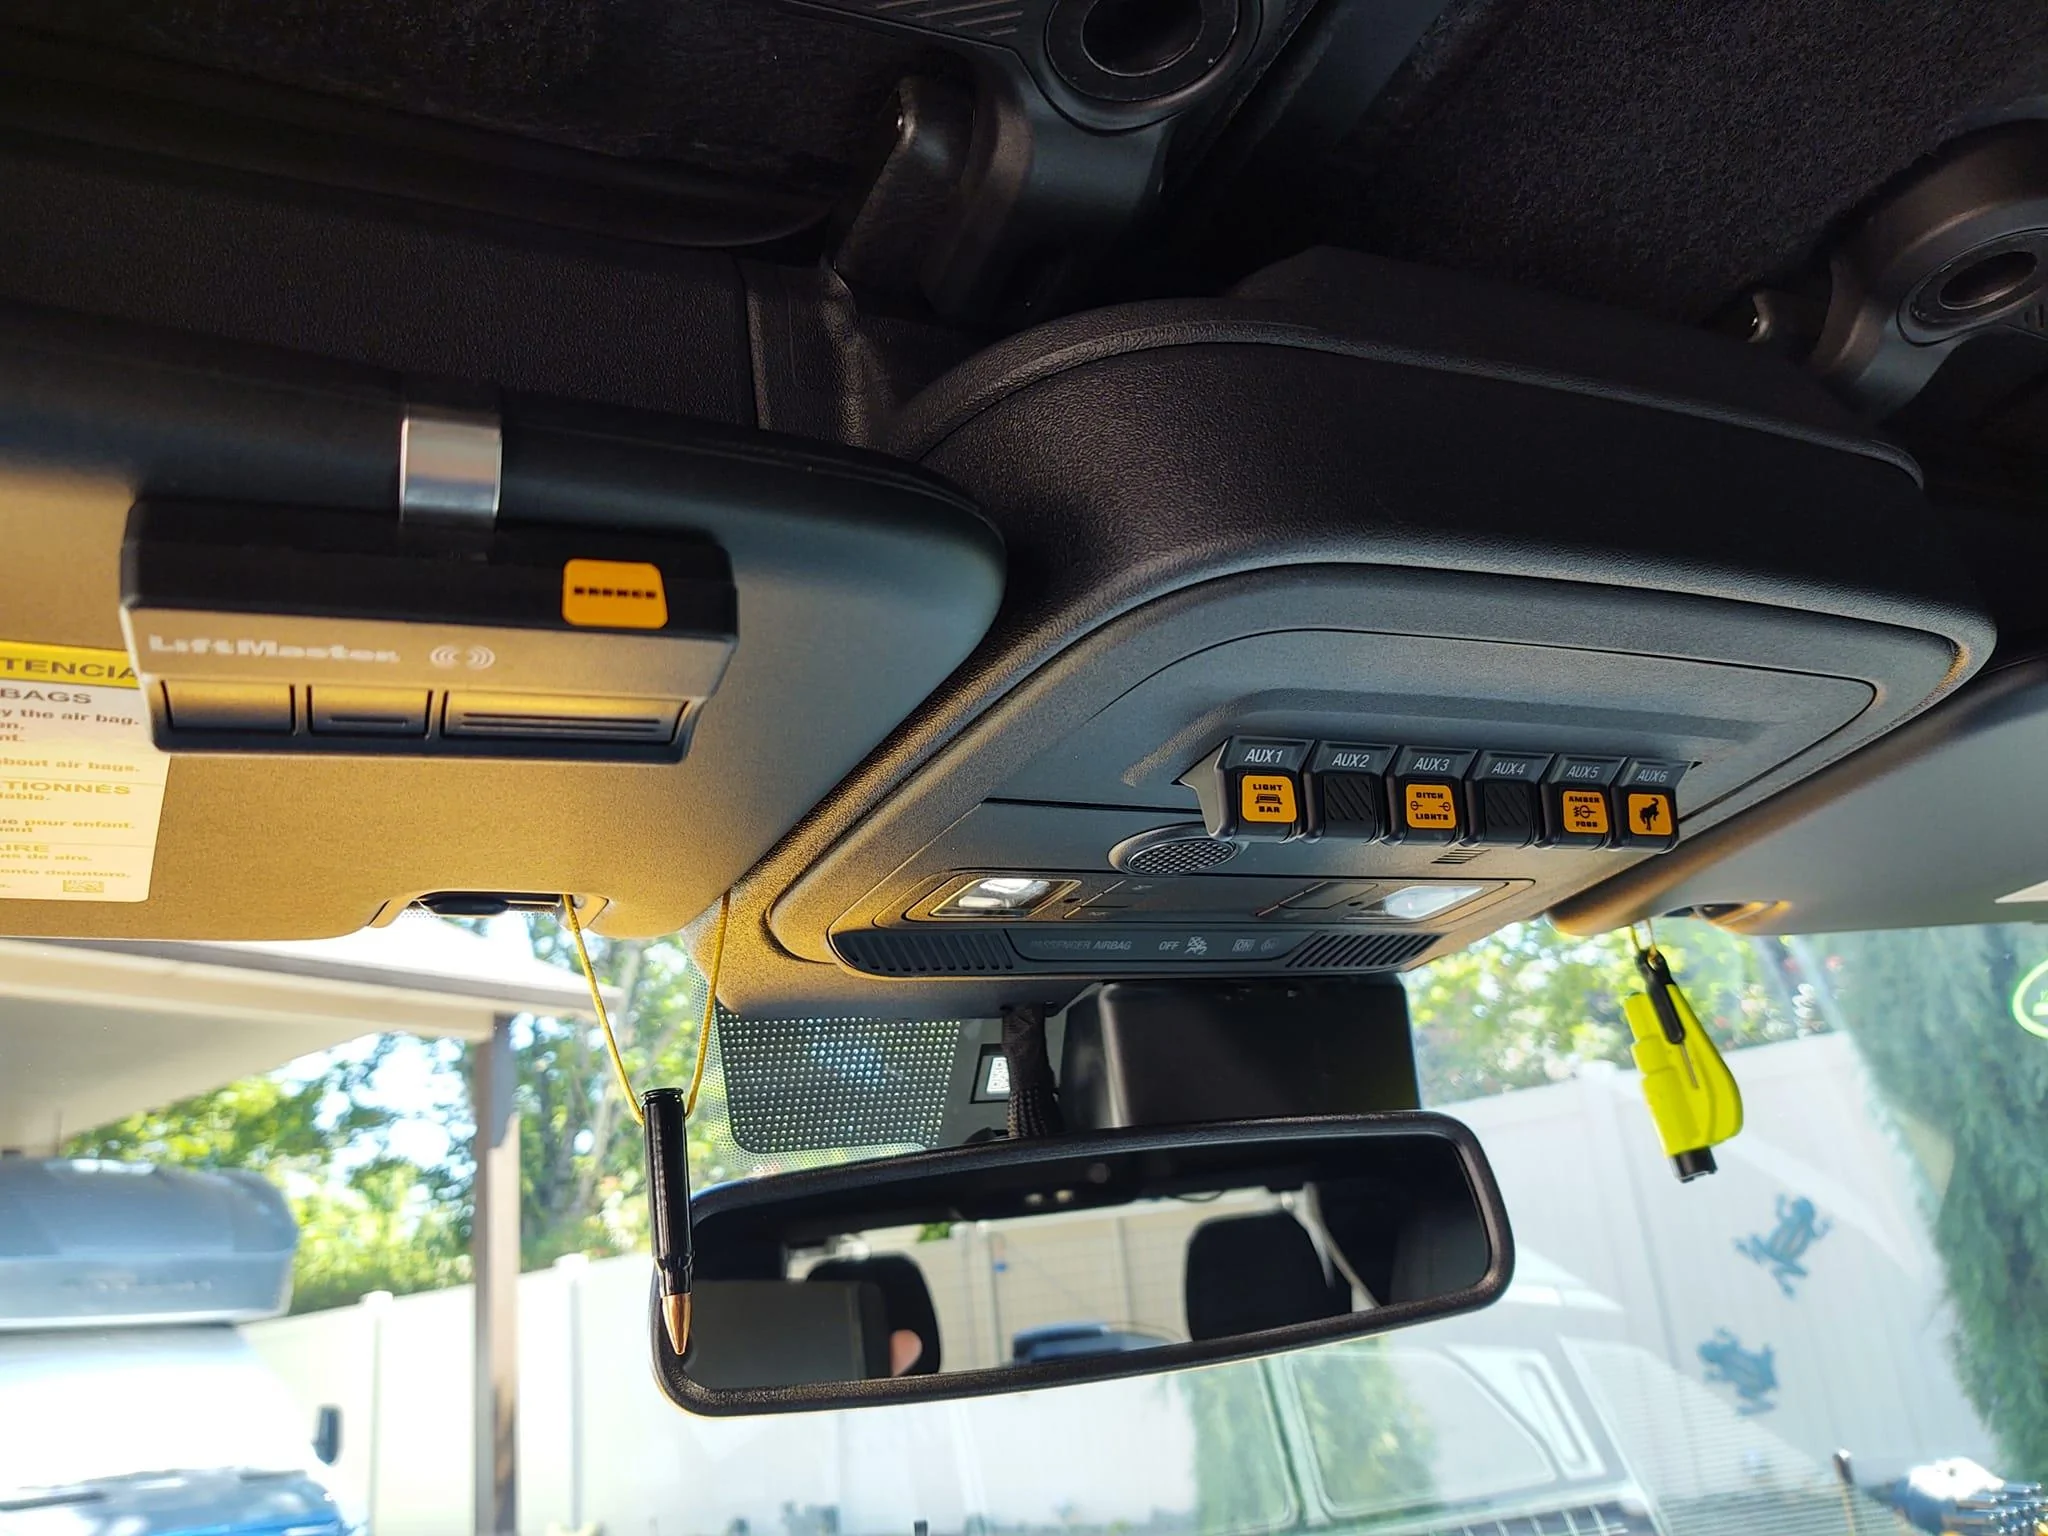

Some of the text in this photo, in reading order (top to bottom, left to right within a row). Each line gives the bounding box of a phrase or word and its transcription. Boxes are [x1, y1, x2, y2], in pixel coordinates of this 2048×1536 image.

[0, 687, 92, 704] BAGS
[20, 709, 54, 720] the
[61, 712, 91, 721] air
[95, 714, 140, 726] bag.
[1244, 748, 1284, 764] AUX1
[1332, 752, 1370, 769] AUX2
[1412, 756, 1450, 772] AUX3
[1491, 761, 1526, 777] AUX4
[1566, 764, 1601, 779] AUX5
[1636, 768, 1669, 783] AUX6
[1252, 783, 1282, 792] LIGHT
[1415, 791, 1444, 800] DITCH
[1568, 795, 1600, 804] AMBER
[1258, 805, 1281, 813] BAR
[1415, 813, 1449, 821] LIGHTS
[1092, 939, 1132, 951] AIRBAG
[1159, 940, 1180, 951] OFF
